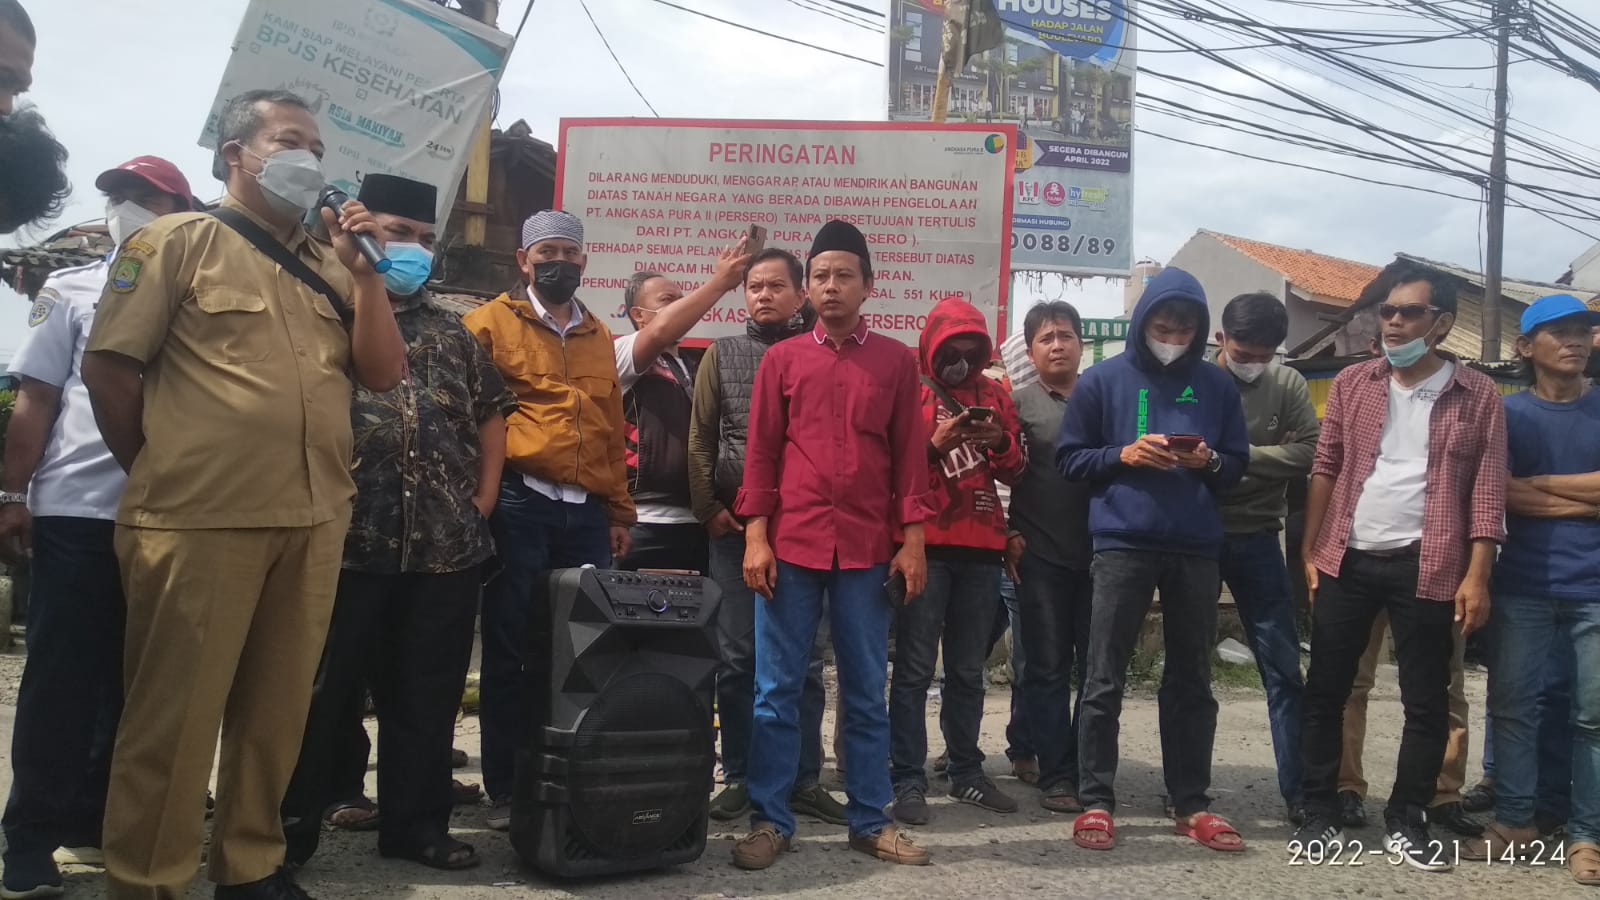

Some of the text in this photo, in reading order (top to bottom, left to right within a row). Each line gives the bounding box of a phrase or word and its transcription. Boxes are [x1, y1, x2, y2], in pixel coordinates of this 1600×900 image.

[998, 0, 1113, 21] HOUSES
[1031, 19, 1104, 34] HADAP JALAN
[264, 11, 299, 33] KAMI
[301, 28, 333, 46] SIAP
[335, 43, 403, 77] MELAYANI
[405, 72, 466, 104] PERTA
[257, 24, 318, 62] BPJS
[323, 53, 463, 124] KESEHATAN
[709, 142, 856, 165] PERINGATAN
[1049, 145, 1128, 159] SEGERA DIBANGUN
[1064, 155, 1110, 166] APRIL 2022
[588, 172, 648, 183] DILARANG
[651, 173, 720, 186] MENDUDUKI,
[802, 177, 831, 188] ATAU
[833, 178, 907, 190] MENDIRIKAN
[910, 179, 978, 191] BANGUNAN
[587, 190, 977, 210] DIATAS TANAH NEGARA YANG BERADA DIBAWAH PENGELOLAAN
[586, 207, 976, 228] PT. ANGKASA PURA II (PERSERO) TANPA PERSETUJUAN TERTULIS
[1039, 219, 1070, 227] HUBUNGI
[636, 226, 670, 237] DARI
[673, 227, 693, 239] PT.
[773, 230, 812, 242] PURA
[585, 242, 644, 254] TERHADAP
[646, 244, 683, 255] SEMUA
[875, 251, 932, 264] TERSEBUT
[935, 253, 975, 265] DIATAS
[634, 261, 697, 274] DIANCAM
[904, 289, 923, 300] 551
